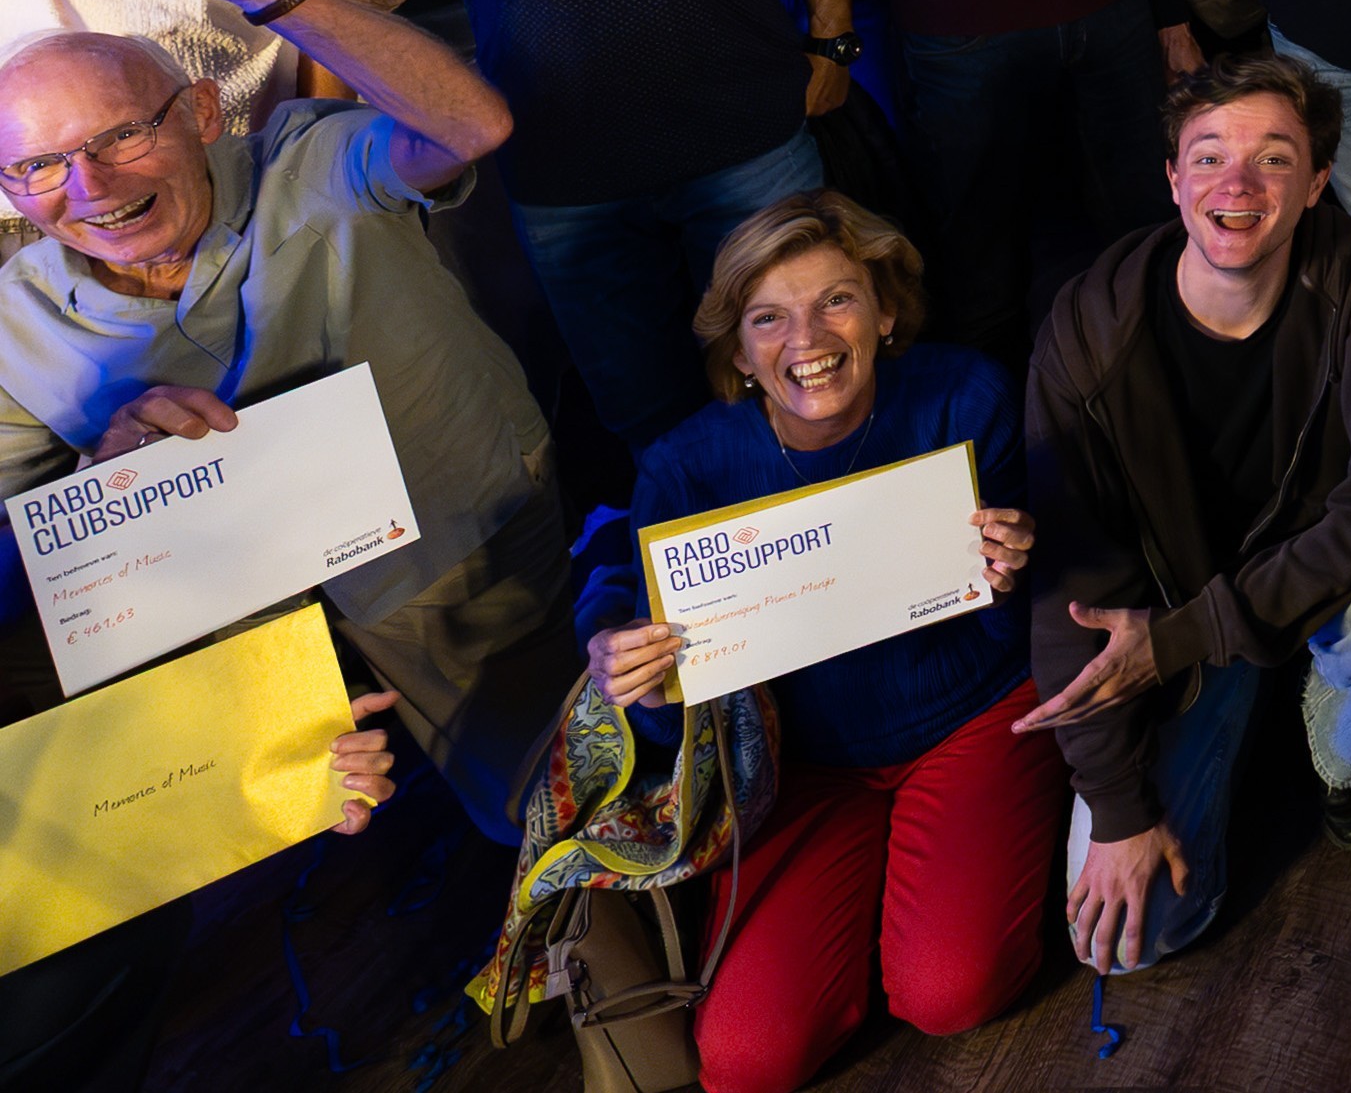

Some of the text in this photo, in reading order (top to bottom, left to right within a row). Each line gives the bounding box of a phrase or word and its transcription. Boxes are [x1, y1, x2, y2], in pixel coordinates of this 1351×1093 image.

[23, 478, 104, 530] RABO
[33, 458, 226, 557] CLUBSUPPORT
[46, 550, 118, 583] Ten behoeve van:
[323, 547, 333, 558] de
[326, 536, 384, 568] Rabobank
[664, 532, 730, 569] RABO
[669, 523, 833, 592] CLUBSUPPORT
[53, 549, 172, 607] Memories of Music
[909, 595, 961, 620] Rabobank
[66, 630, 78, 646] €
[93, 760, 216, 817] Memories of Music
